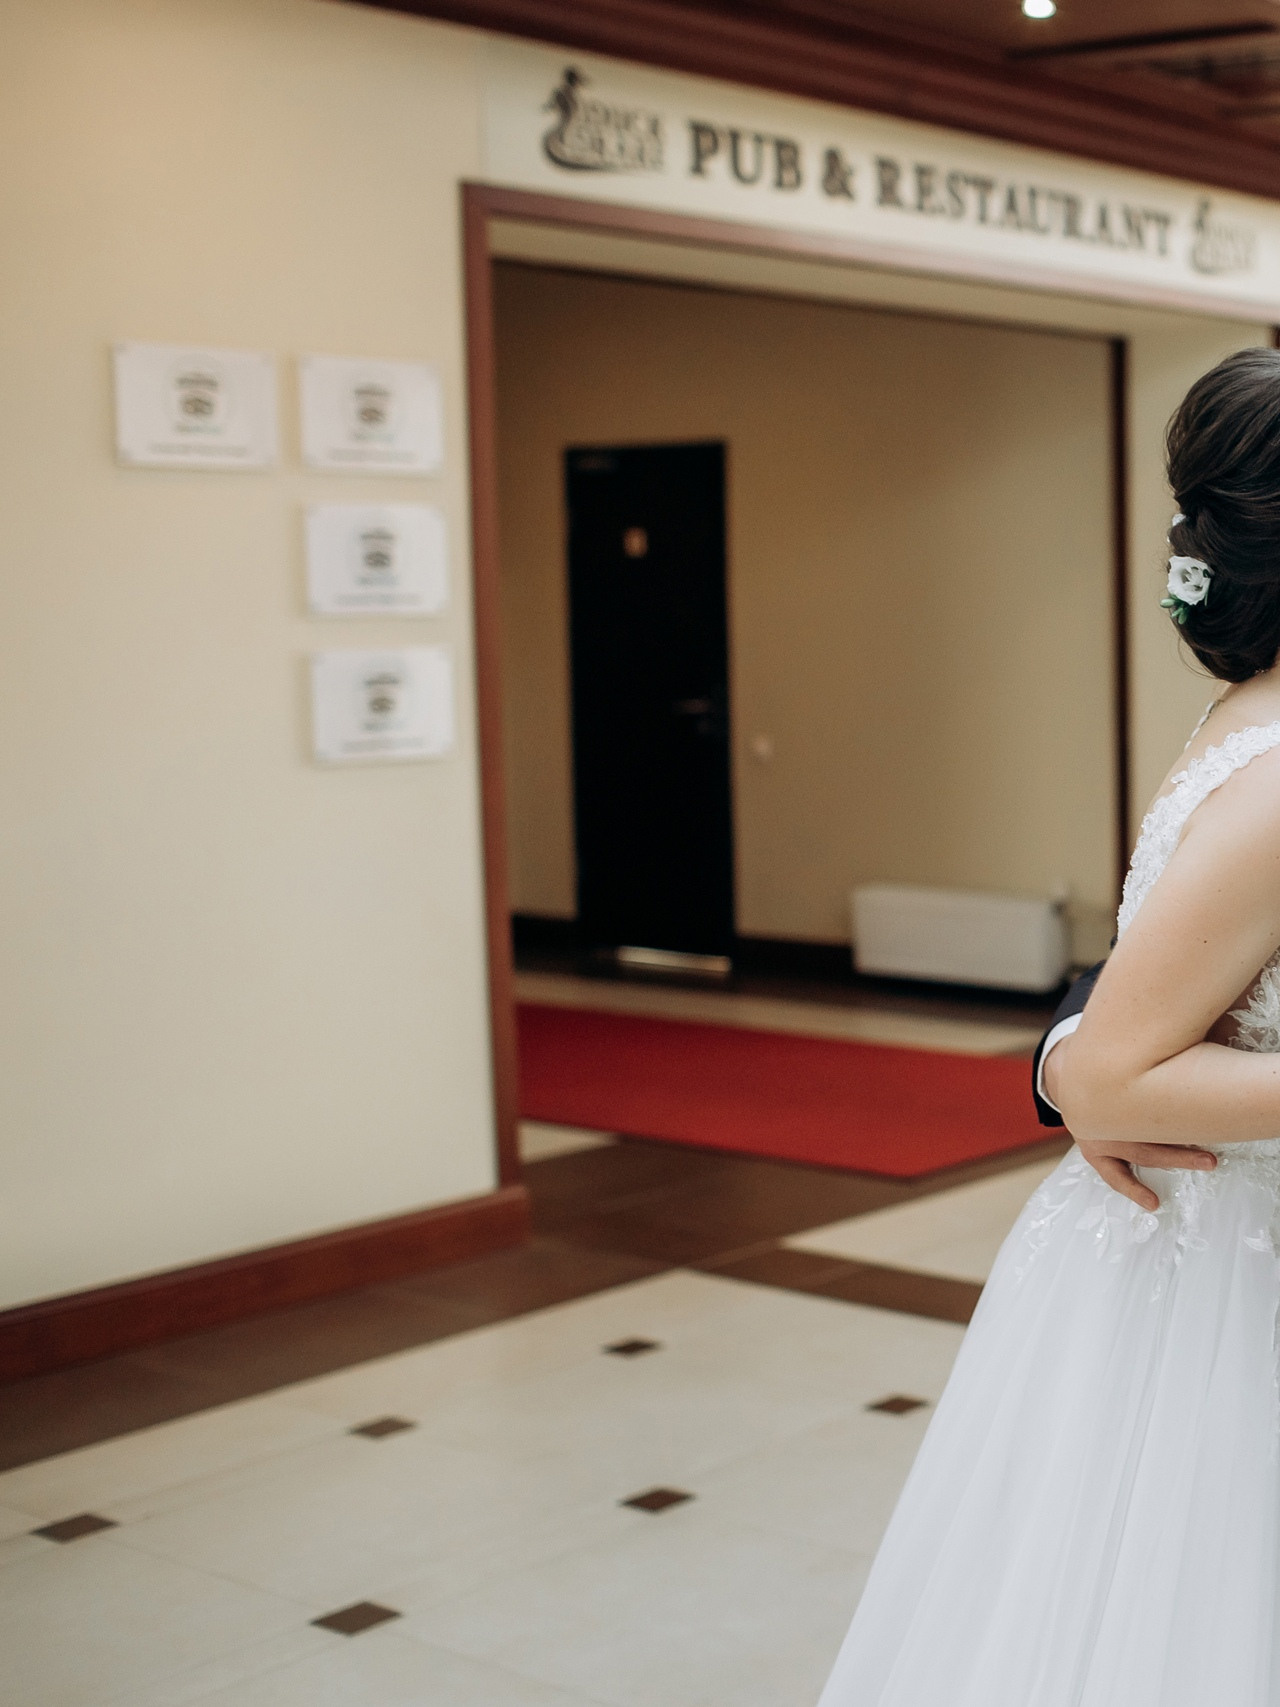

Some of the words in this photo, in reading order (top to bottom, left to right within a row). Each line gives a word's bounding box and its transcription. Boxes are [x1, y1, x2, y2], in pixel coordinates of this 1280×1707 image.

[691, 121, 803, 191] PUB
[822, 147, 855, 202] &
[875, 155, 1170, 258] RESTAURANT
